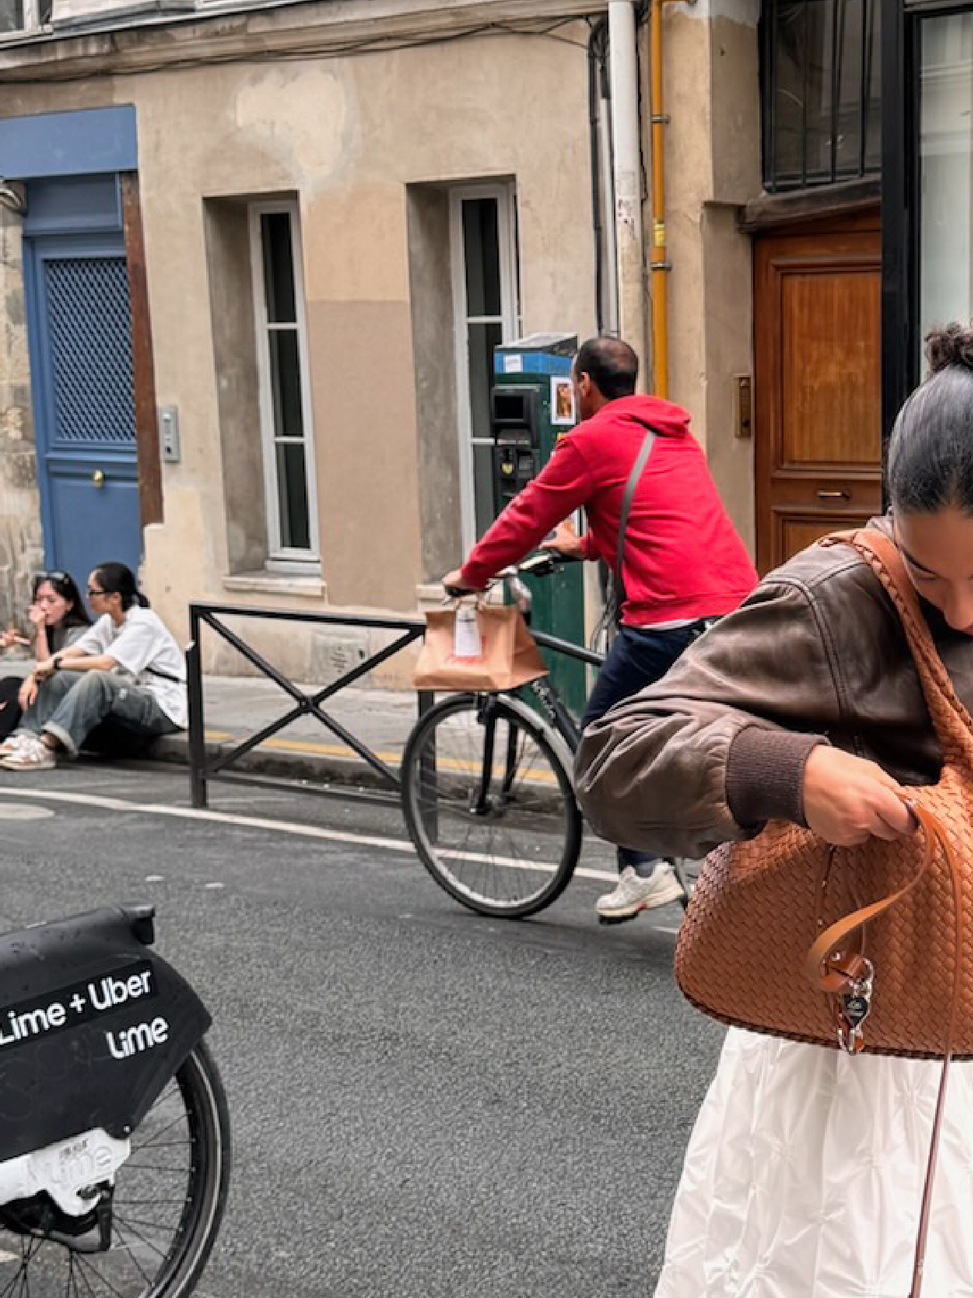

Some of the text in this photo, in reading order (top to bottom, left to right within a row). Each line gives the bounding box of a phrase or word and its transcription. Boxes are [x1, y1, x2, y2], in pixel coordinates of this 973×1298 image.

[69, 993, 86, 1013] +
[88, 970, 151, 1010] Uber
[105, 1016, 169, 1059] Lime
